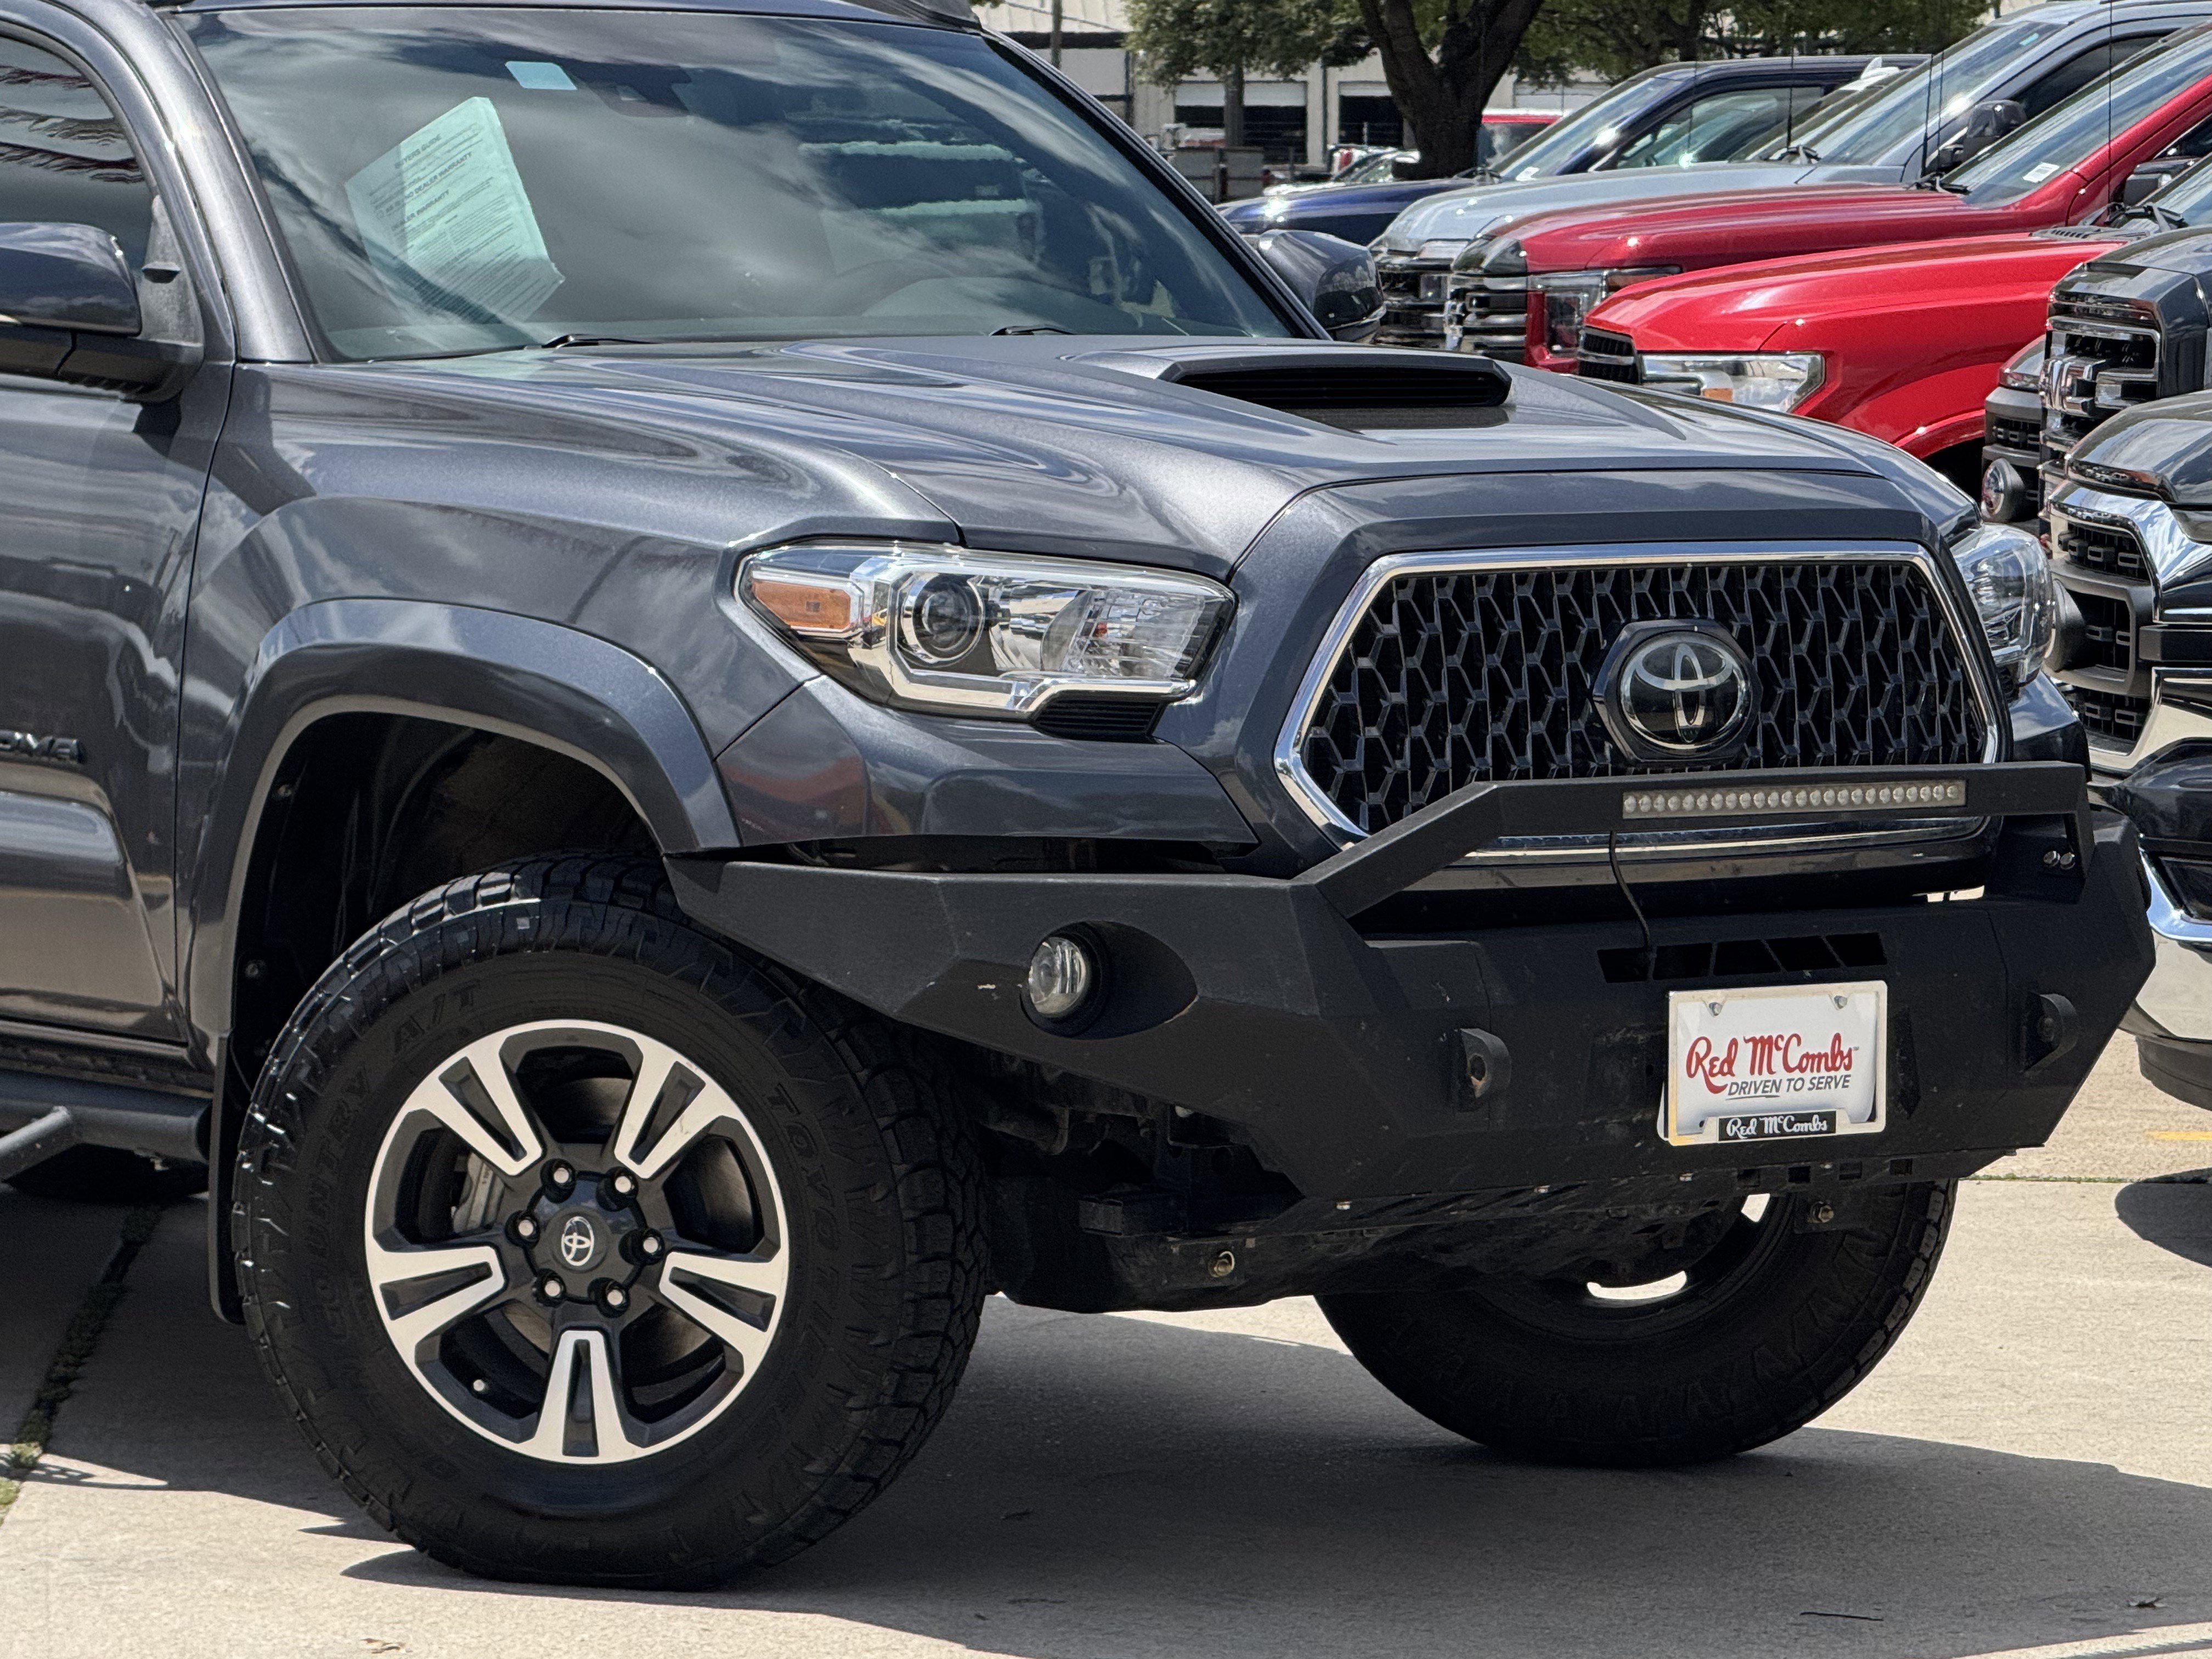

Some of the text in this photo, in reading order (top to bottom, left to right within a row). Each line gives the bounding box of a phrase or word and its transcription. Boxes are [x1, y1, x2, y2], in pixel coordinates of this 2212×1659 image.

[420, 133, 442, 151] GUIDE
[1686, 1036, 1739, 1094] Red
[1727, 1074, 1852, 1096] DRIVEN TO SERVE
[1726, 1114, 1827, 1139] Red McCombs
[766, 1081, 838, 1251] TOYO
